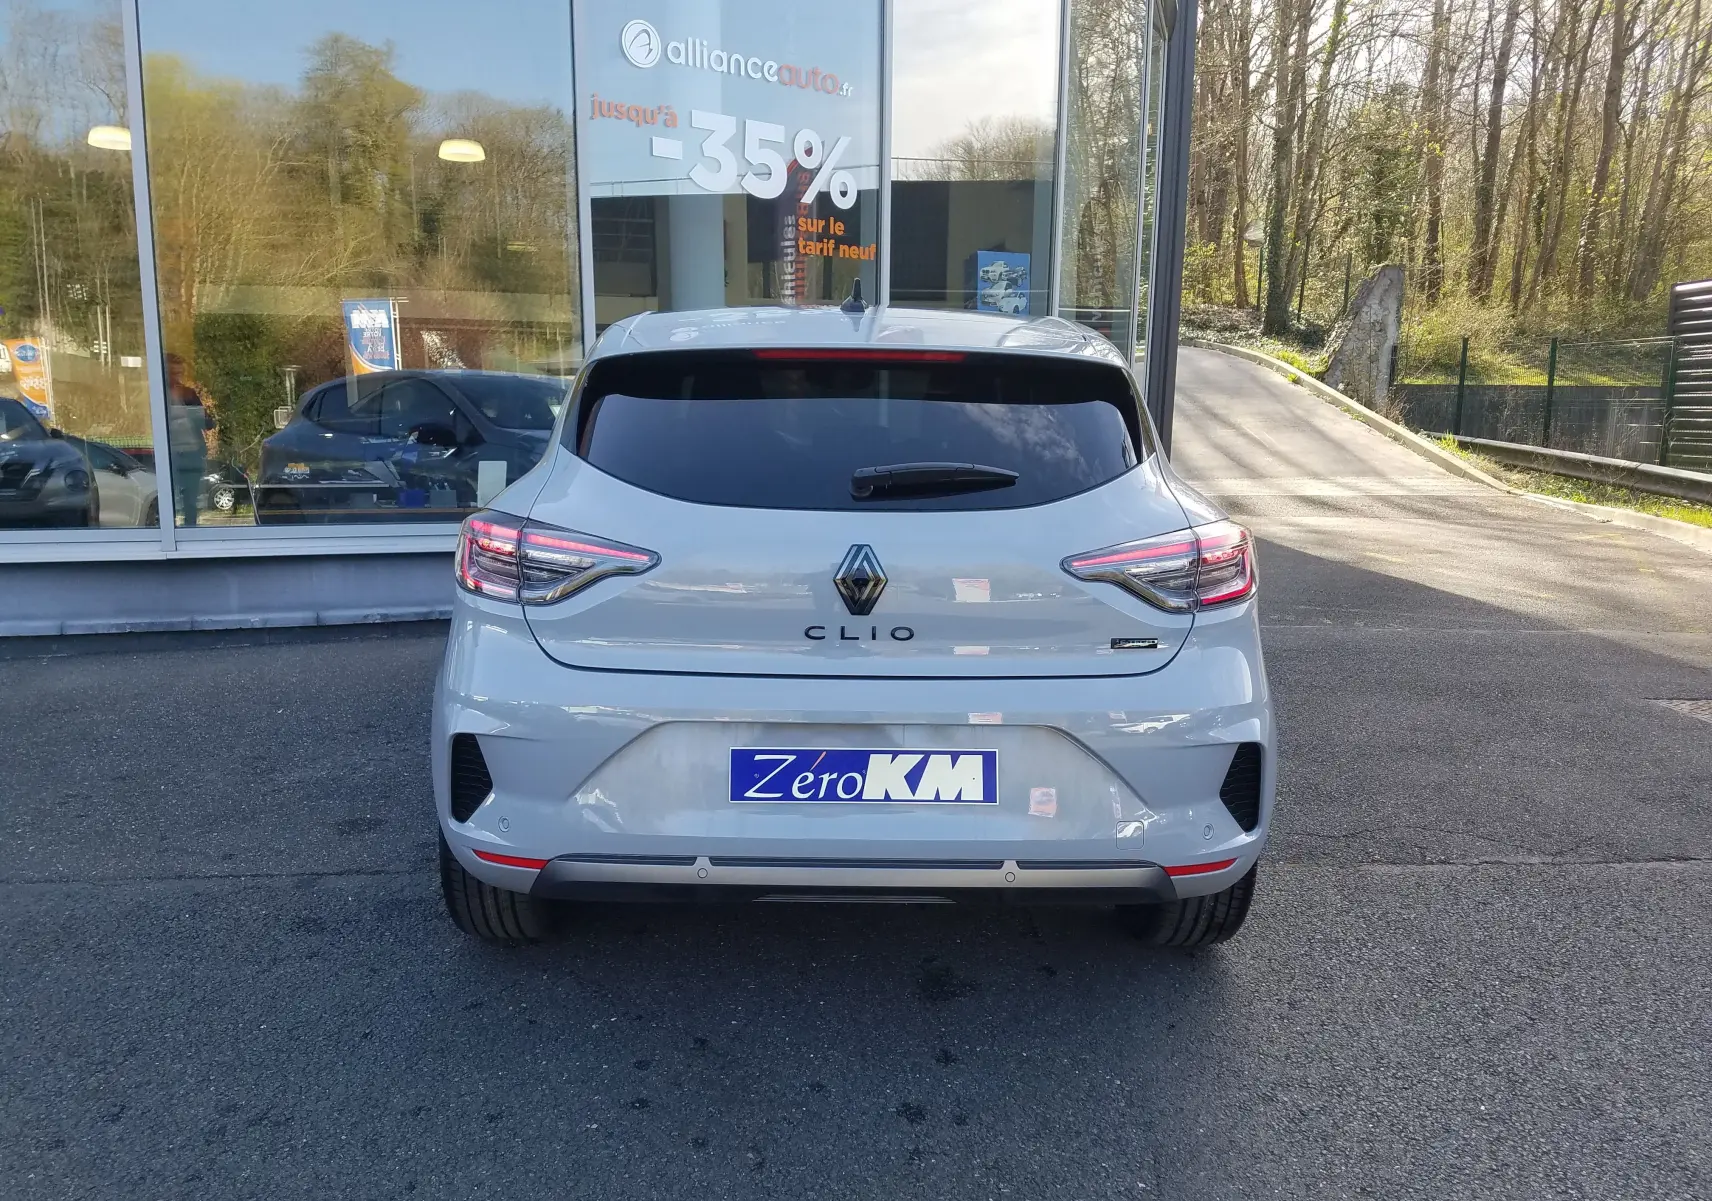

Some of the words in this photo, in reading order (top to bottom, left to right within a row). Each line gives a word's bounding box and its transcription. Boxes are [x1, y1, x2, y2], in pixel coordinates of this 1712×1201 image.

[590, 93, 679, 127] jusqu'à
[652, 109, 858, 210] -35%
[798, 216, 825, 233] sur
[829, 216, 845, 235] le
[798, 238, 835, 256] tarif
[840, 243, 876, 260] neuf
[804, 625, 915, 641] CLIO
